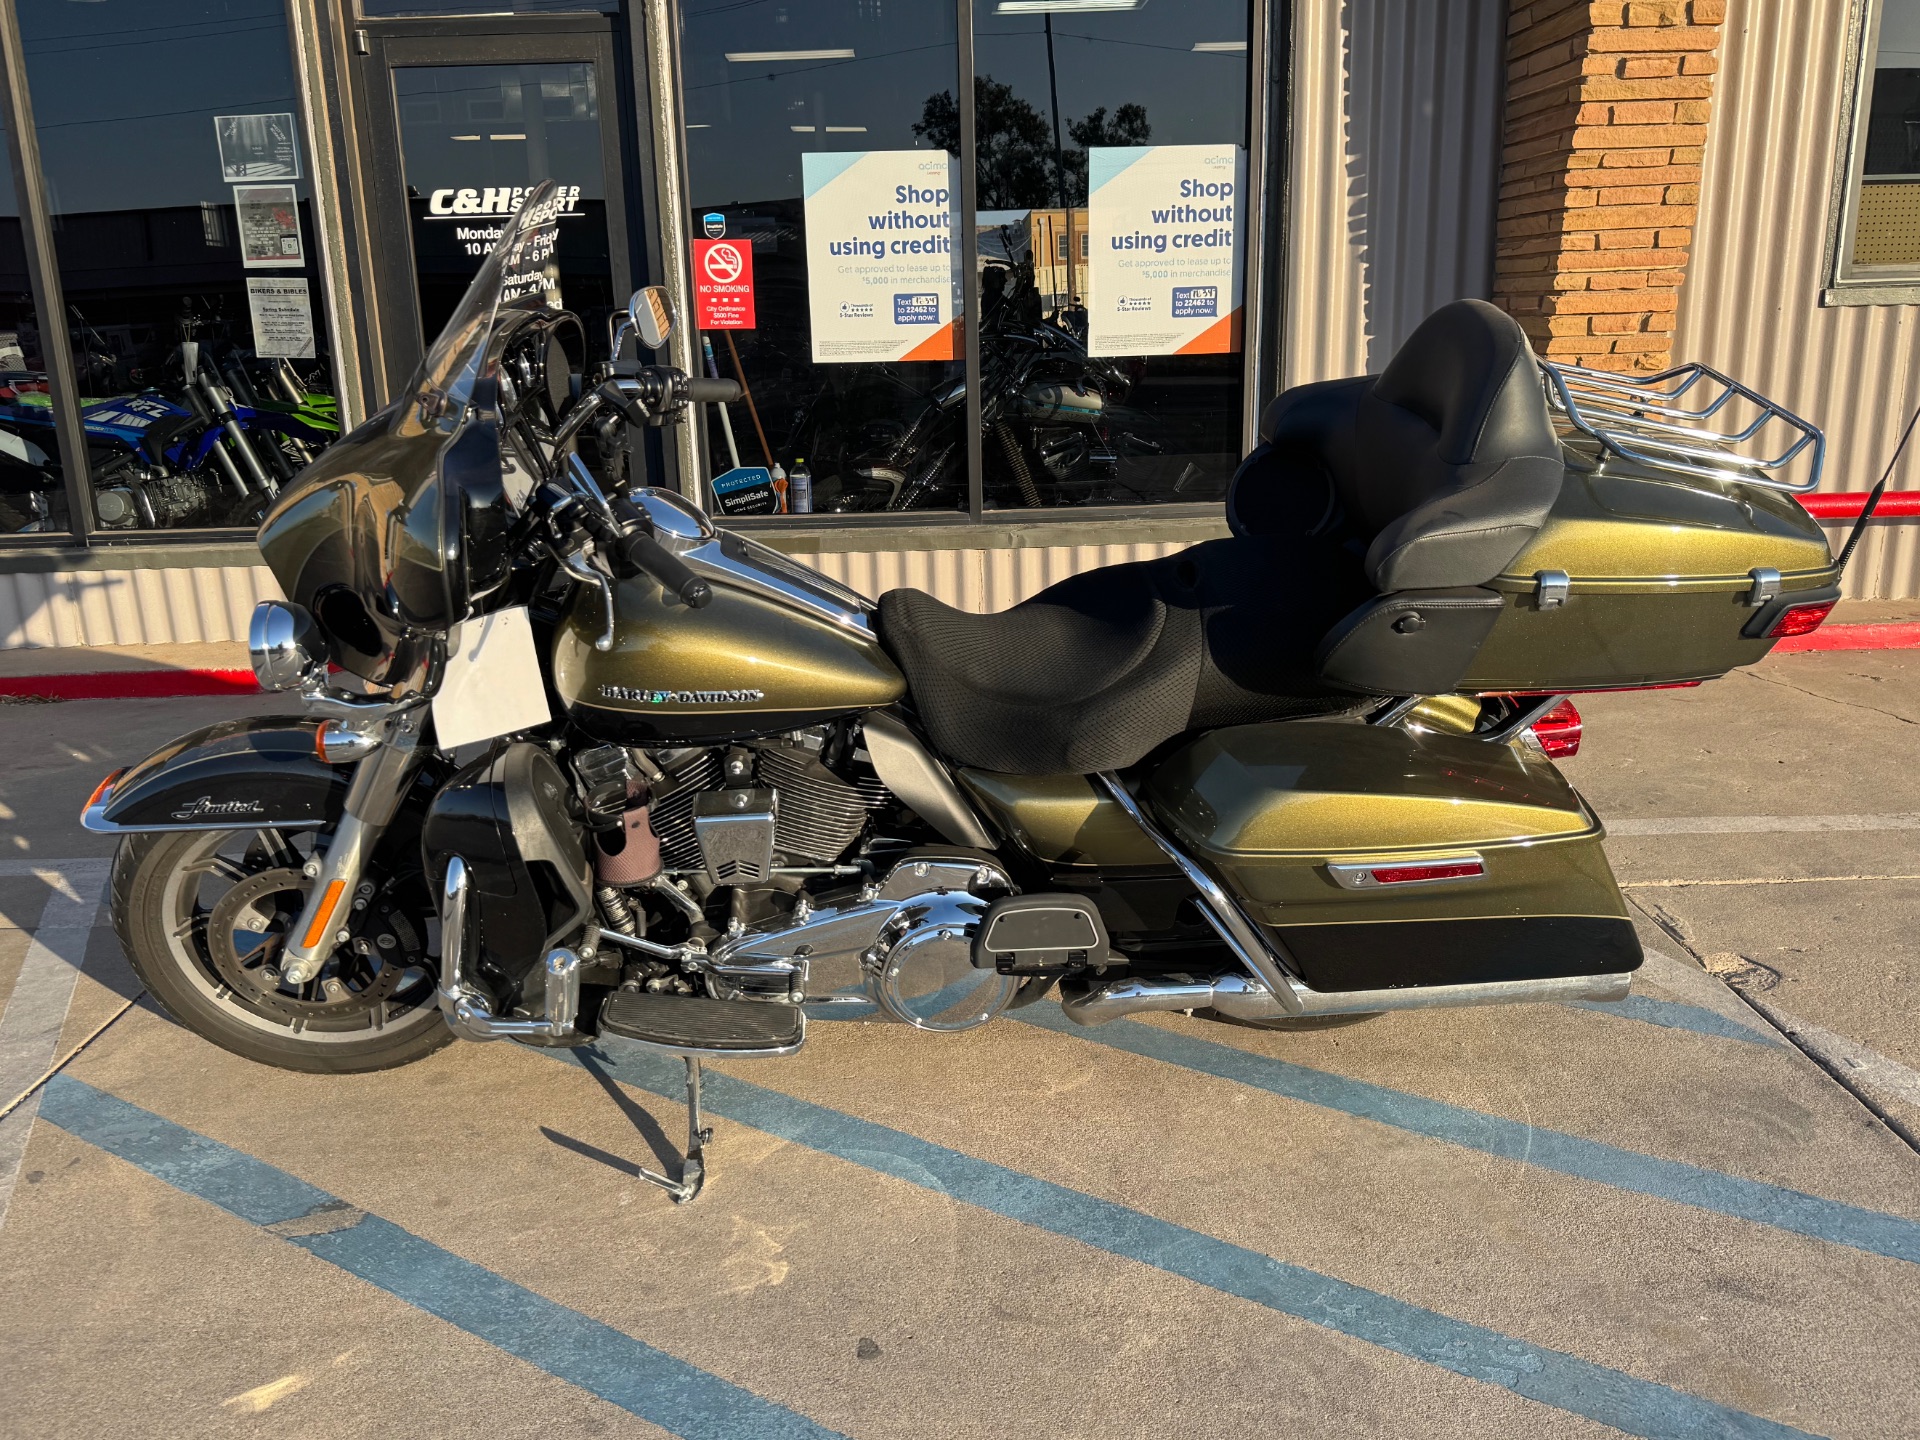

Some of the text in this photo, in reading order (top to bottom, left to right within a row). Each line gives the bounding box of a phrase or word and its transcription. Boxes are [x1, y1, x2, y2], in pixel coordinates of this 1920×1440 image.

[1205, 155, 1234, 165] acima
[895, 184, 949, 207] Shop
[1180, 179, 1234, 201] Shop
[429, 187, 511, 215] C&H
[868, 210, 950, 230] without
[1151, 204, 1233, 224] without
[464, 242, 481, 255] 10
[829, 237, 886, 259] using
[1111, 231, 1167, 253] using
[838, 266, 853, 274] Get
[855, 265, 895, 275] approved
[896, 265, 905, 273] to
[907, 264, 929, 272] lease
[930, 264, 941, 272] up
[1118, 259, 1133, 267] Get
[1135, 258, 1174, 269] approved
[1188, 257, 1209, 266] lease
[1210, 258, 1221, 268] up
[1170, 270, 1178, 278] in
[1180, 268, 1232, 278] merchandise
[890, 276, 898, 285] in
[900, 275, 952, 284] merchandise
[700, 285, 750, 293] NO SMOKING
[897, 298, 911, 306] Text
[1184, 299, 1206, 307] 22462
[1175, 307, 1195, 316] apply
[898, 314, 917, 323] apply
[721, 474, 761, 488] PROTECTED
[724, 490, 769, 507] SimpliSafe
[171, 796, 264, 820] Limited
